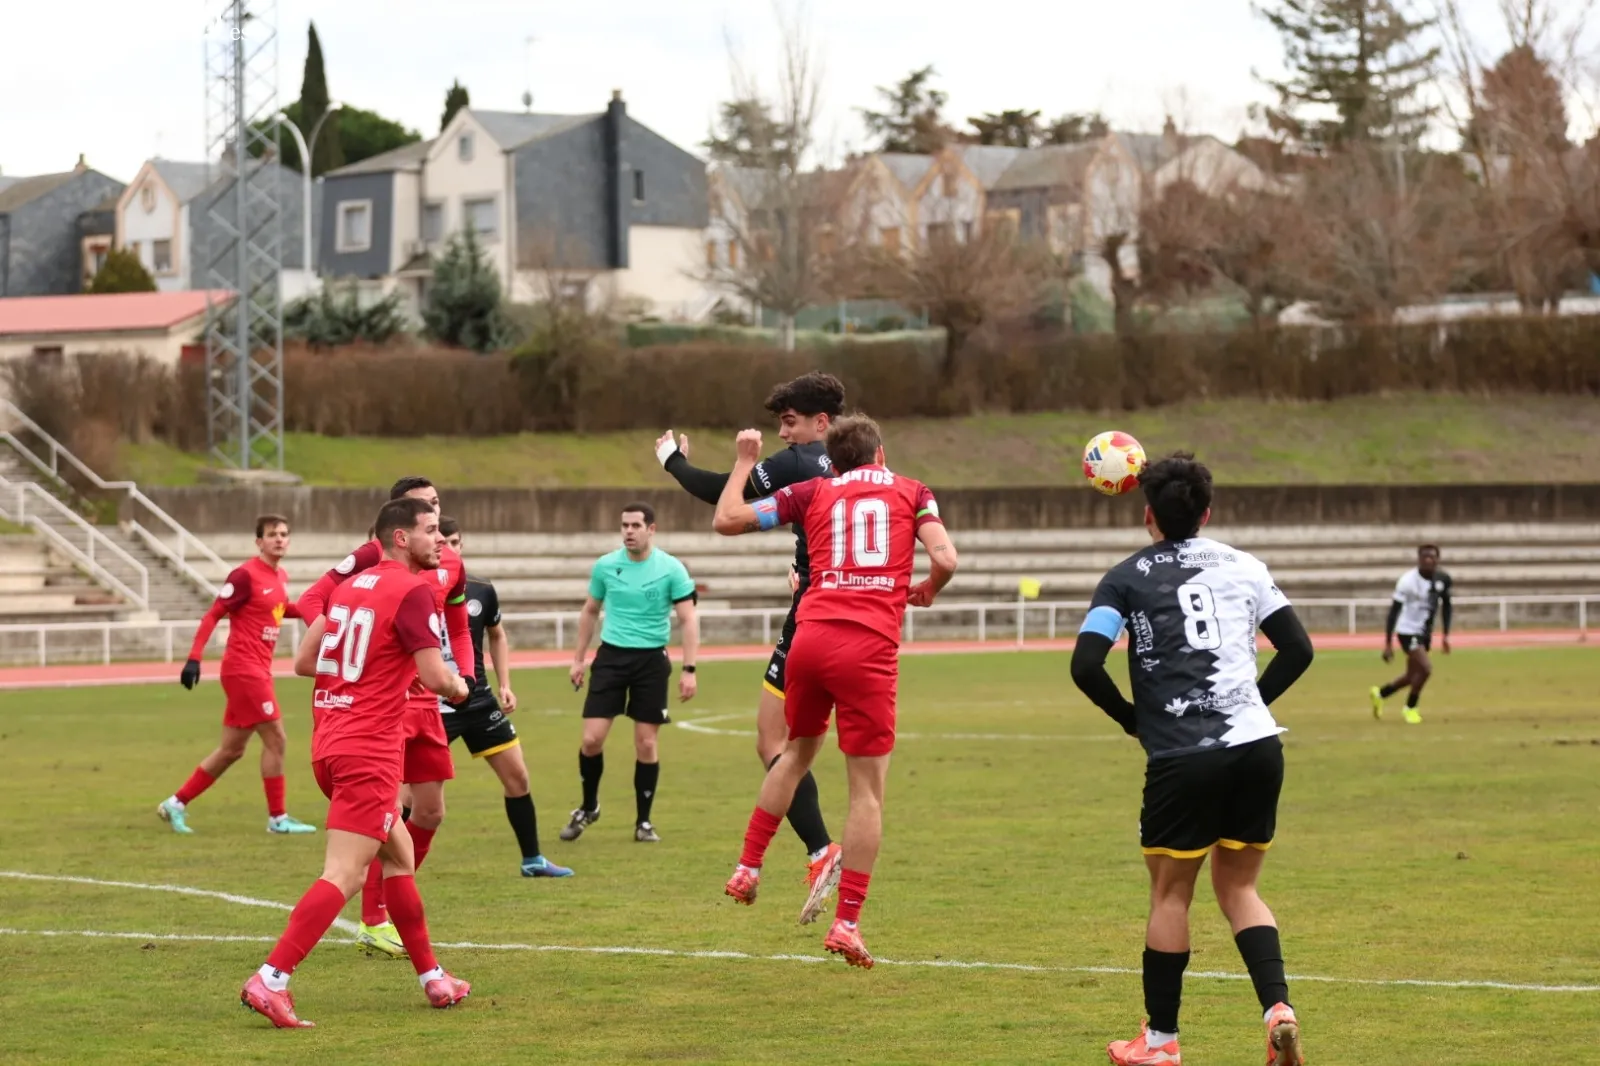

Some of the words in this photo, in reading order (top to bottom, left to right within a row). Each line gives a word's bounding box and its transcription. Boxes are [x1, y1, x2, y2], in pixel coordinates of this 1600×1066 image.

[831, 469, 894, 487] SANTOS
[831, 498, 889, 569] 10
[1154, 553, 1173, 565] De
[1177, 551, 1219, 563] Castro
[839, 571, 895, 588] Limcasa
[1136, 610, 1153, 651] CHARRA
[1177, 582, 1223, 651] 8
[316, 604, 375, 683] 20
